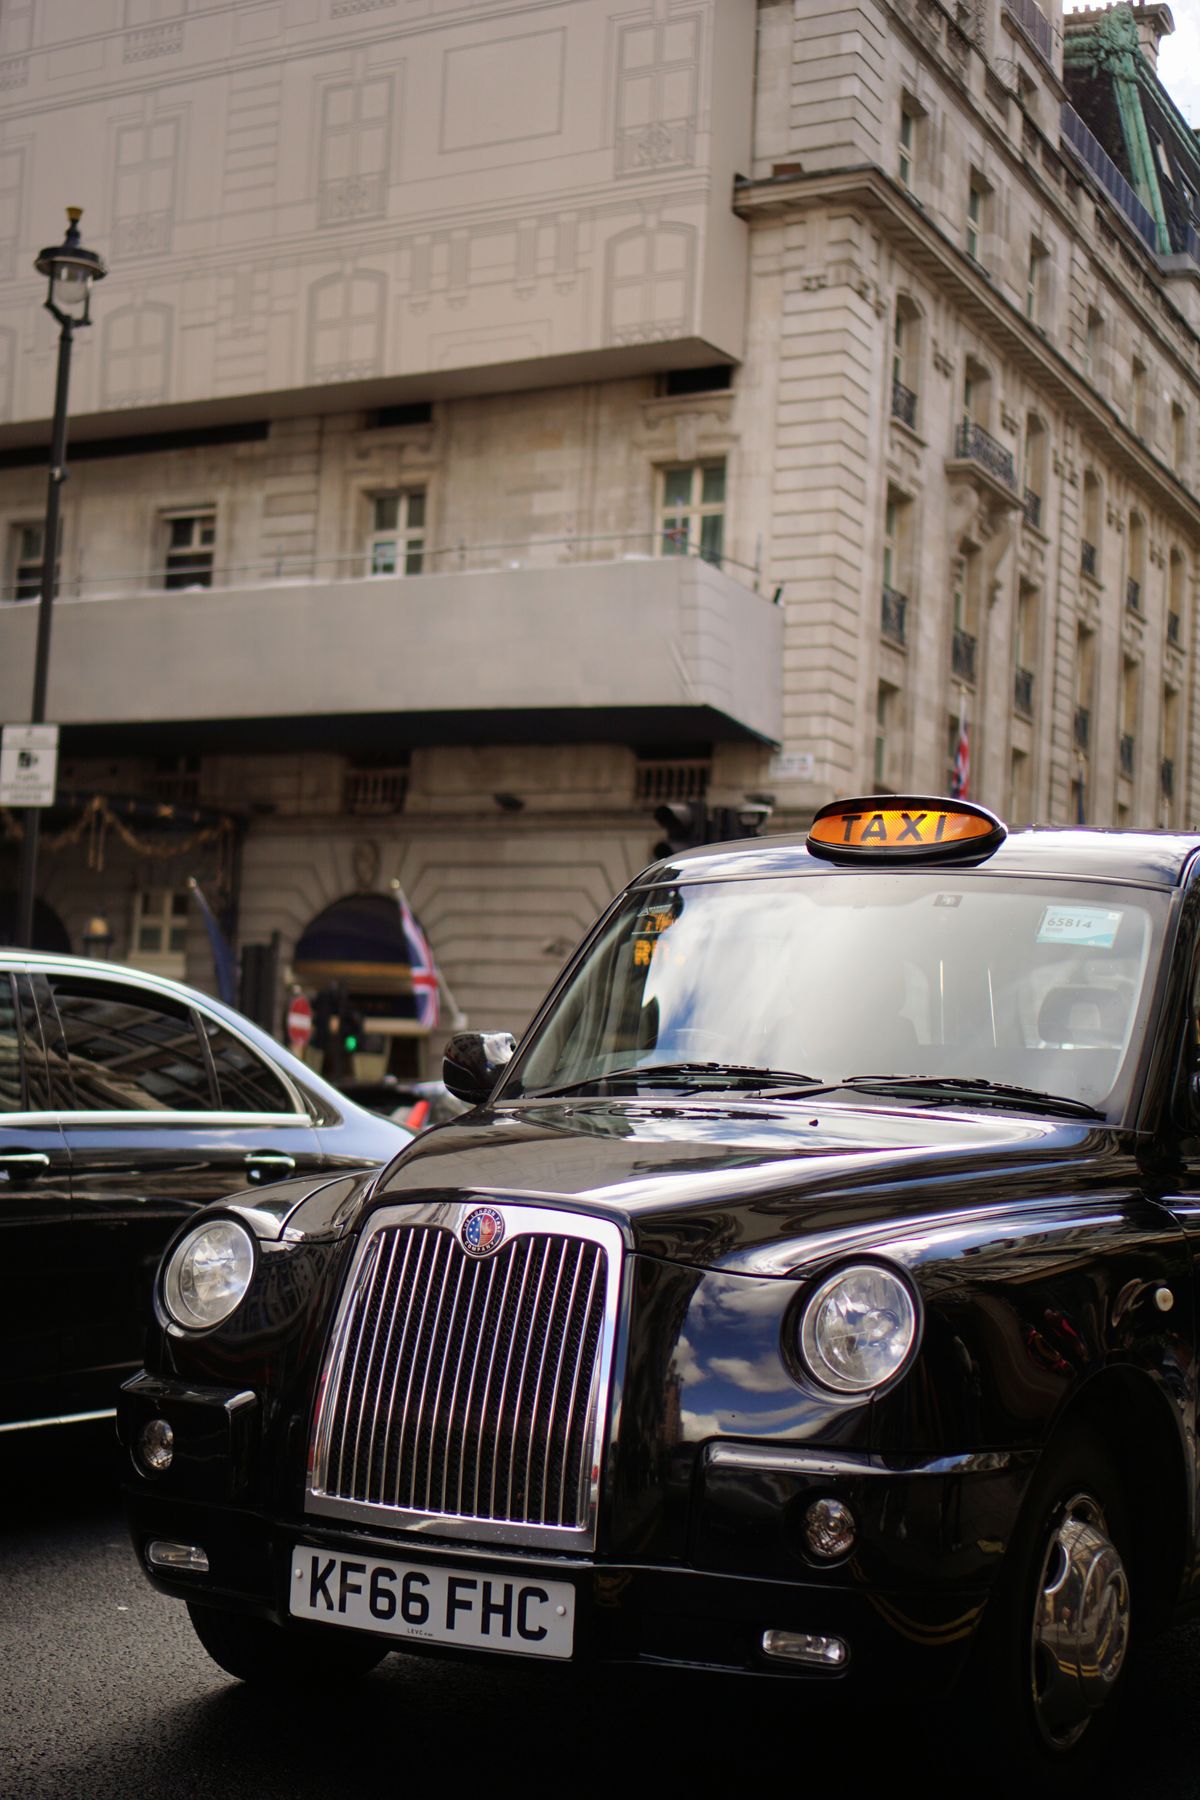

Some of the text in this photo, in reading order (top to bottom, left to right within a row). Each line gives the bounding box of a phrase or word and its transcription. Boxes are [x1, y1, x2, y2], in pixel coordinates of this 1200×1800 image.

[841, 813, 947, 842] TAXI
[1047, 918, 1093, 928] 65814
[470, 1208, 495, 1218] LONDON
[465, 1240, 495, 1251] COMPANY
[309, 1555, 549, 1641] KF66 FHC
